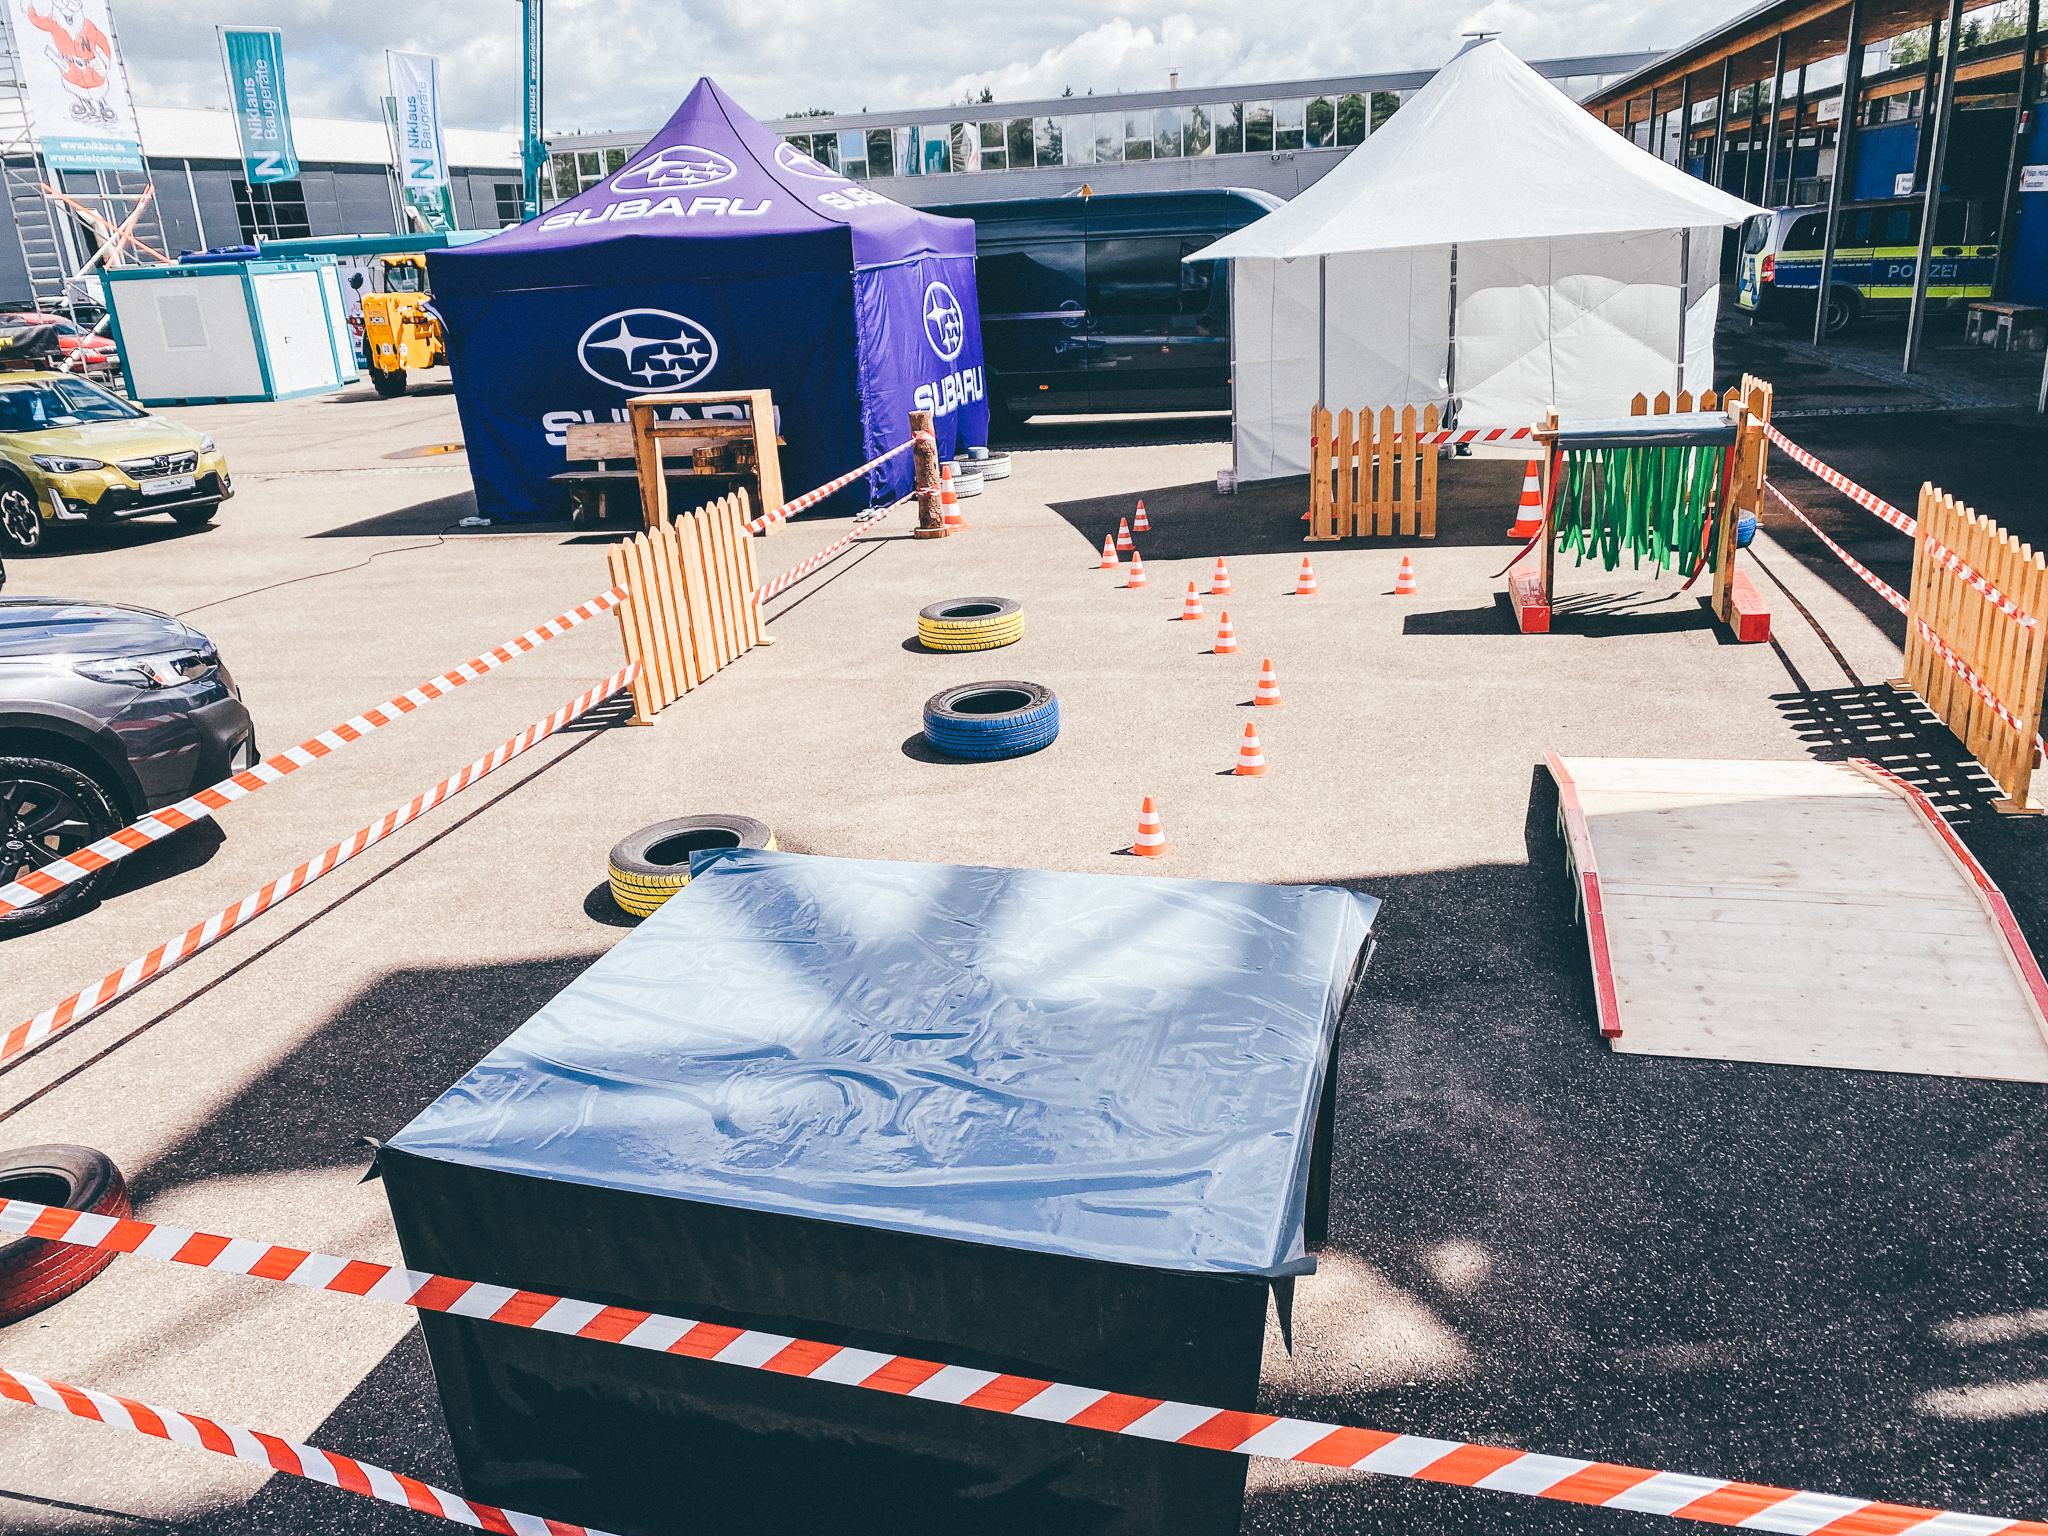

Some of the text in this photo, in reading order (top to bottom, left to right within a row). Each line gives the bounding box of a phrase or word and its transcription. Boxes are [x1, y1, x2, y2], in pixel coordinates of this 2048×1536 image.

[243, 77, 264, 140] Niklaus
[254, 58, 278, 140] Baugeräte
[406, 95, 420, 149] Niklaus
[417, 80, 433, 150] Baugeräte
[252, 150, 284, 176] N
[409, 157, 435, 180] N
[537, 196, 772, 232] SUBARU
[1887, 264, 1958, 278] POZEI
[914, 365, 984, 418] SUBARU
